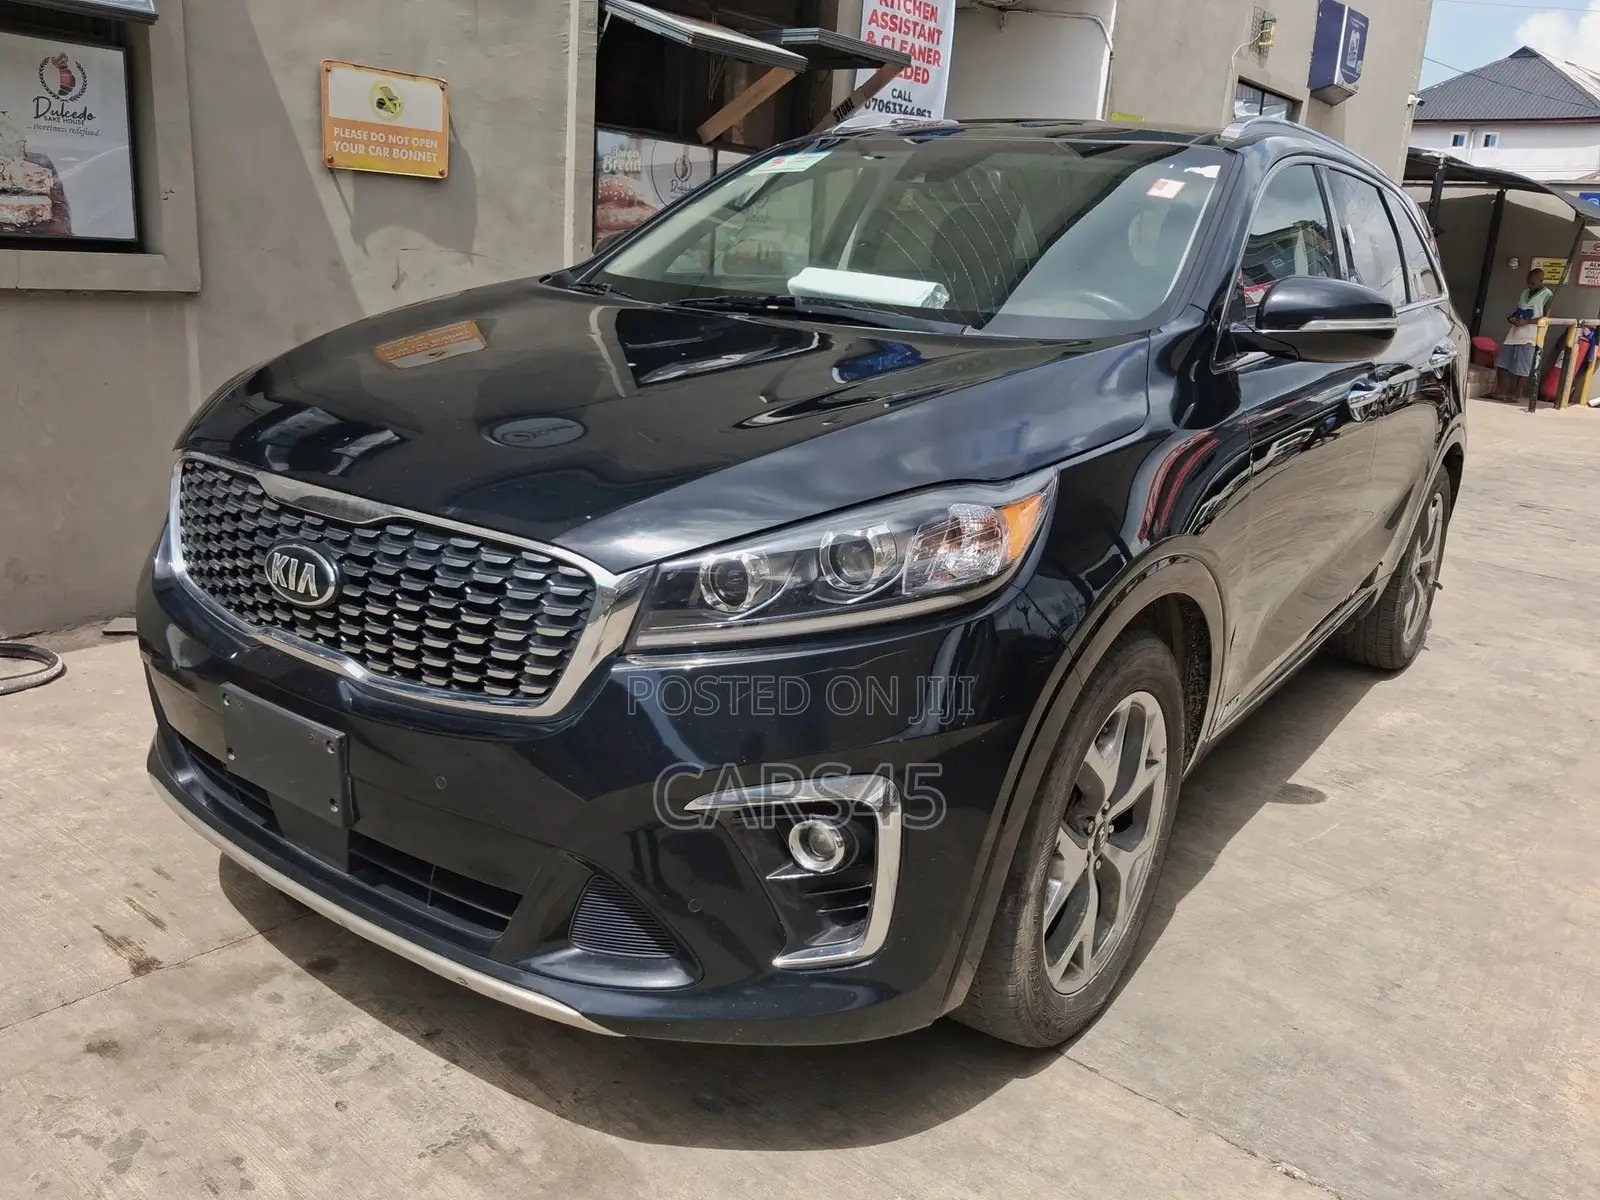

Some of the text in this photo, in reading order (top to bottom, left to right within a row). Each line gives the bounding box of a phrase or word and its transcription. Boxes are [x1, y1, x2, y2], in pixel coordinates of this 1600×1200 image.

[868, 9, 943, 46] ASSISTANT
[891, 88, 913, 103] CALL
[32, 95, 97, 121] Dulcedo
[43, 115, 86, 126] BAKE HOUSE
[333, 127, 438, 149] PLEASE DO NOT OPEN
[333, 141, 438, 163] YOUR CAR BONNET
[271, 552, 319, 598] KIA
